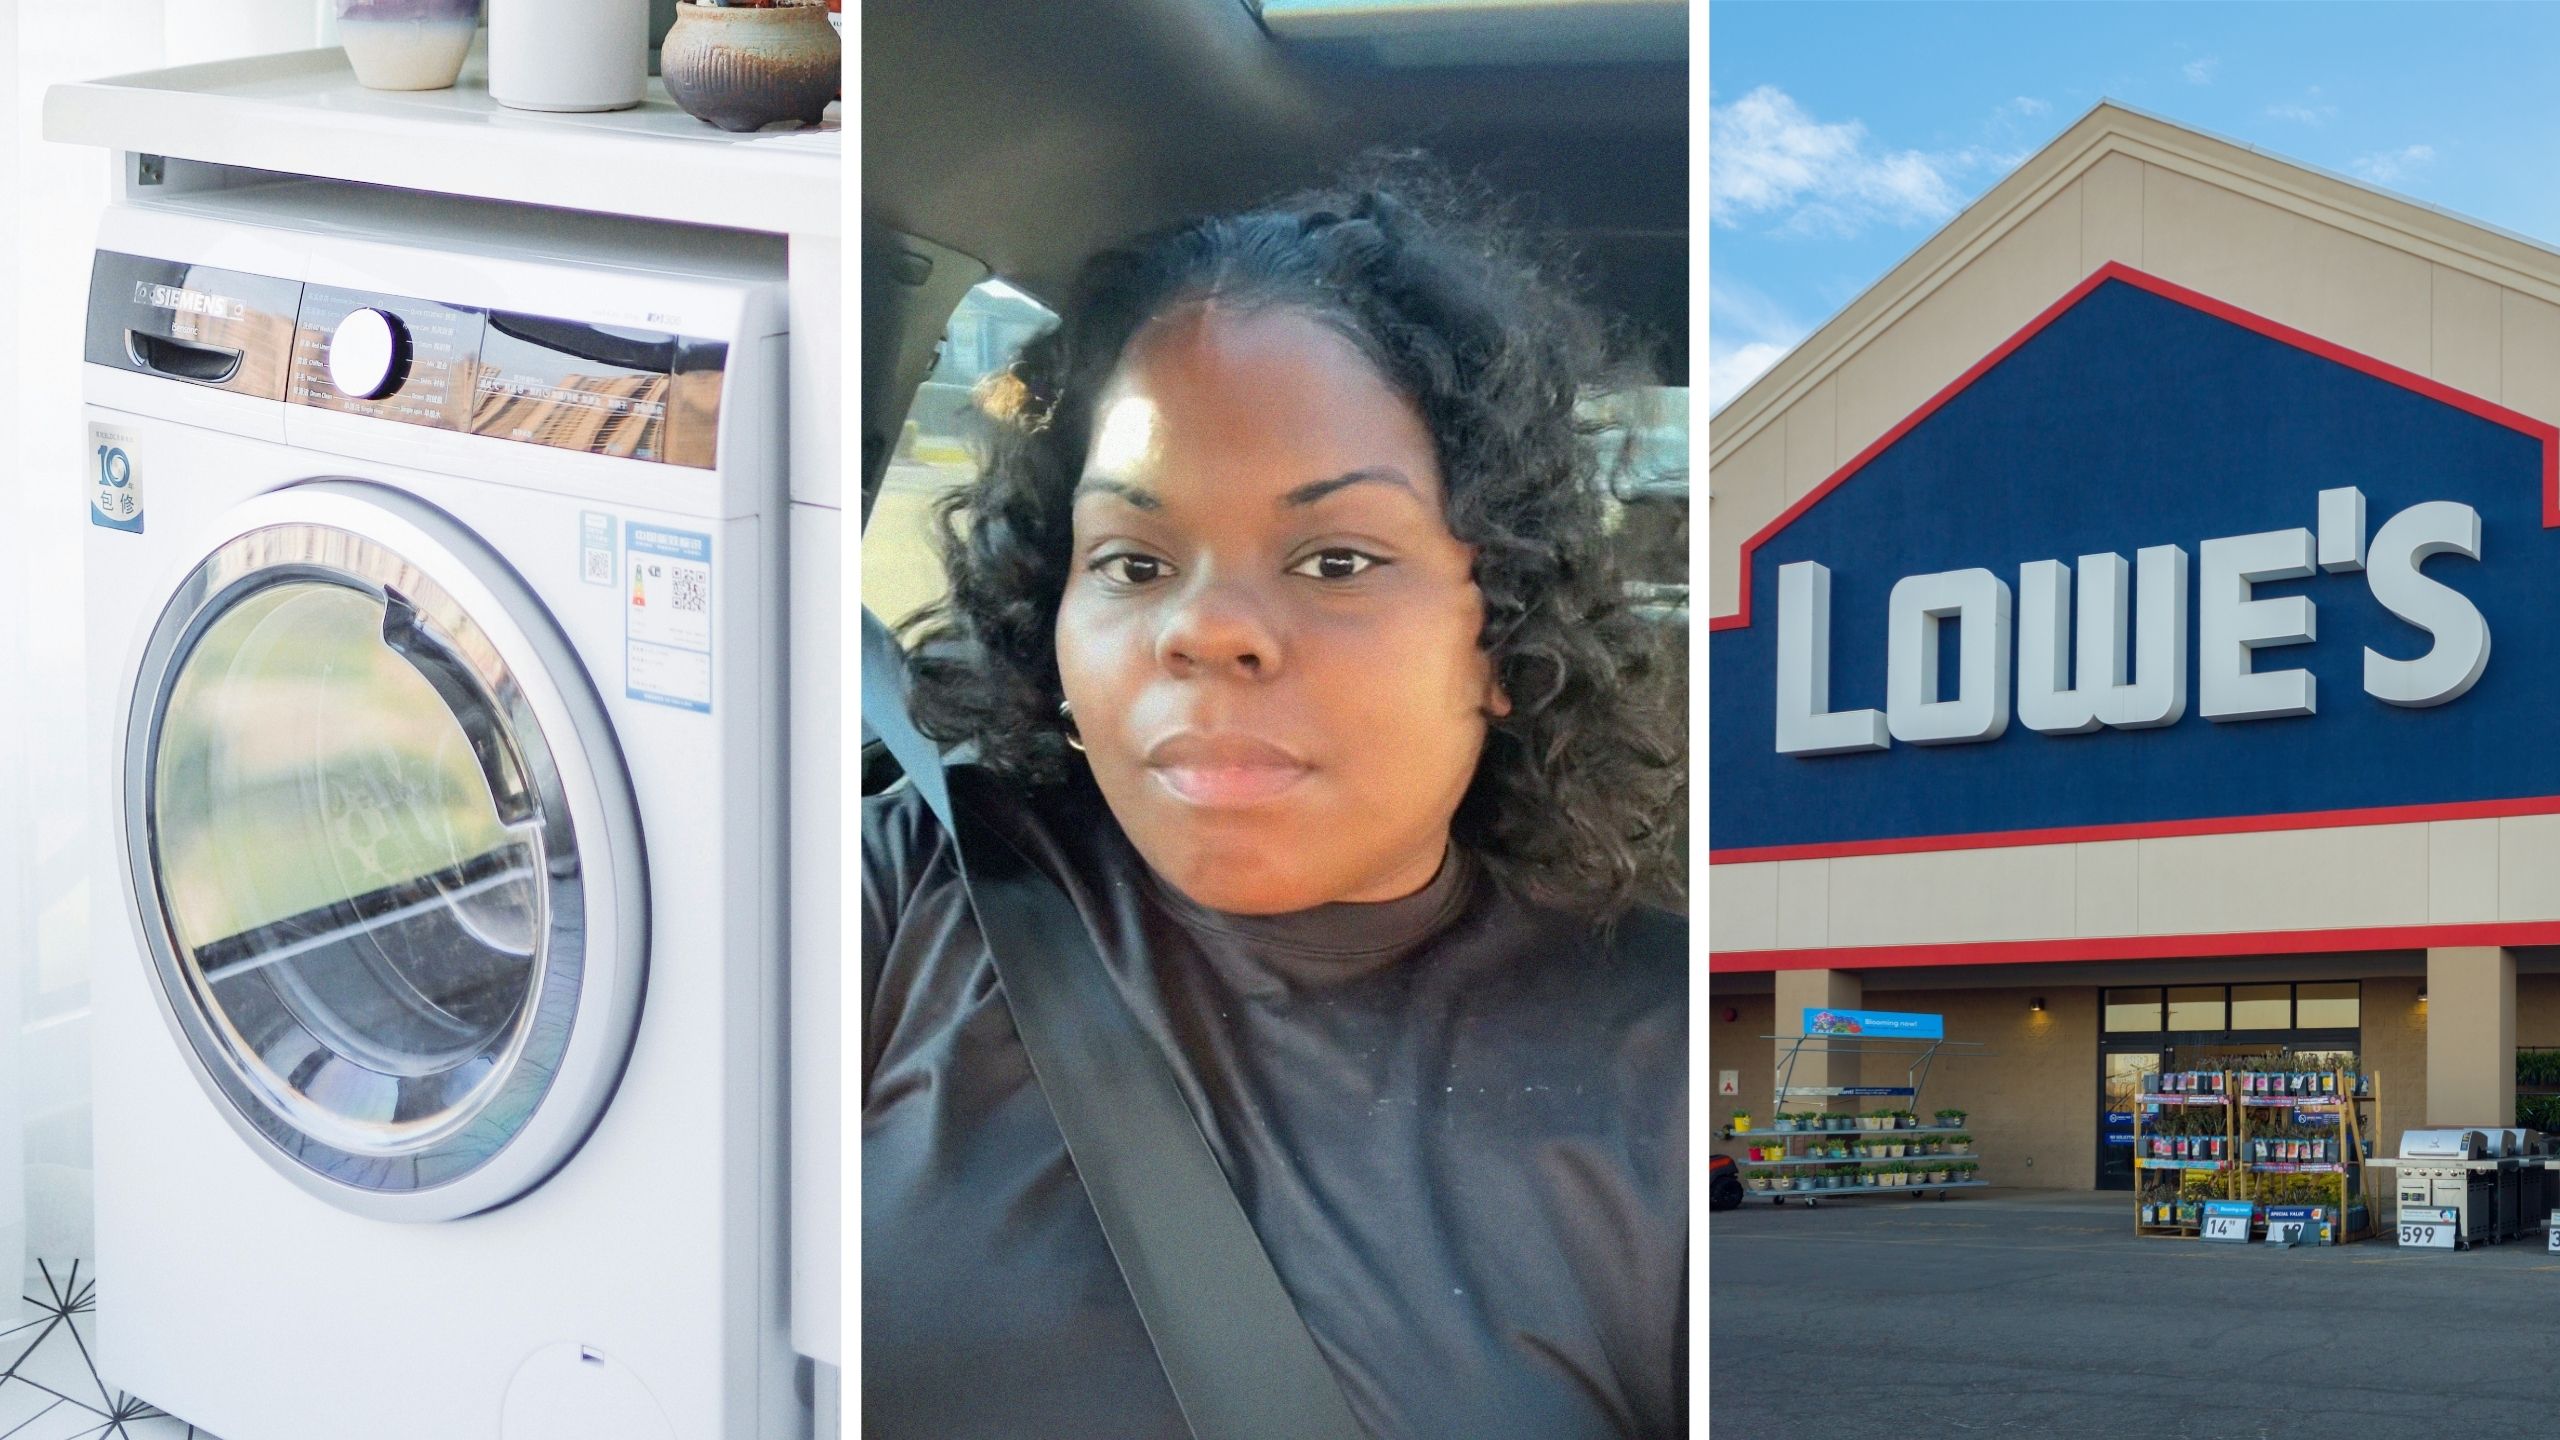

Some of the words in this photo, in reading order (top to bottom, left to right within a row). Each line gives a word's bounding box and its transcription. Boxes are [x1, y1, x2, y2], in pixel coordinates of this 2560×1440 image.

[155, 287, 225, 316] SIEMENS
[1776, 485, 2492, 757] LOWE'S
[1864, 1018, 1899, 1028] Blooming
[2210, 1219, 2228, 1236] 14
[2402, 1226, 2435, 1244] 599
